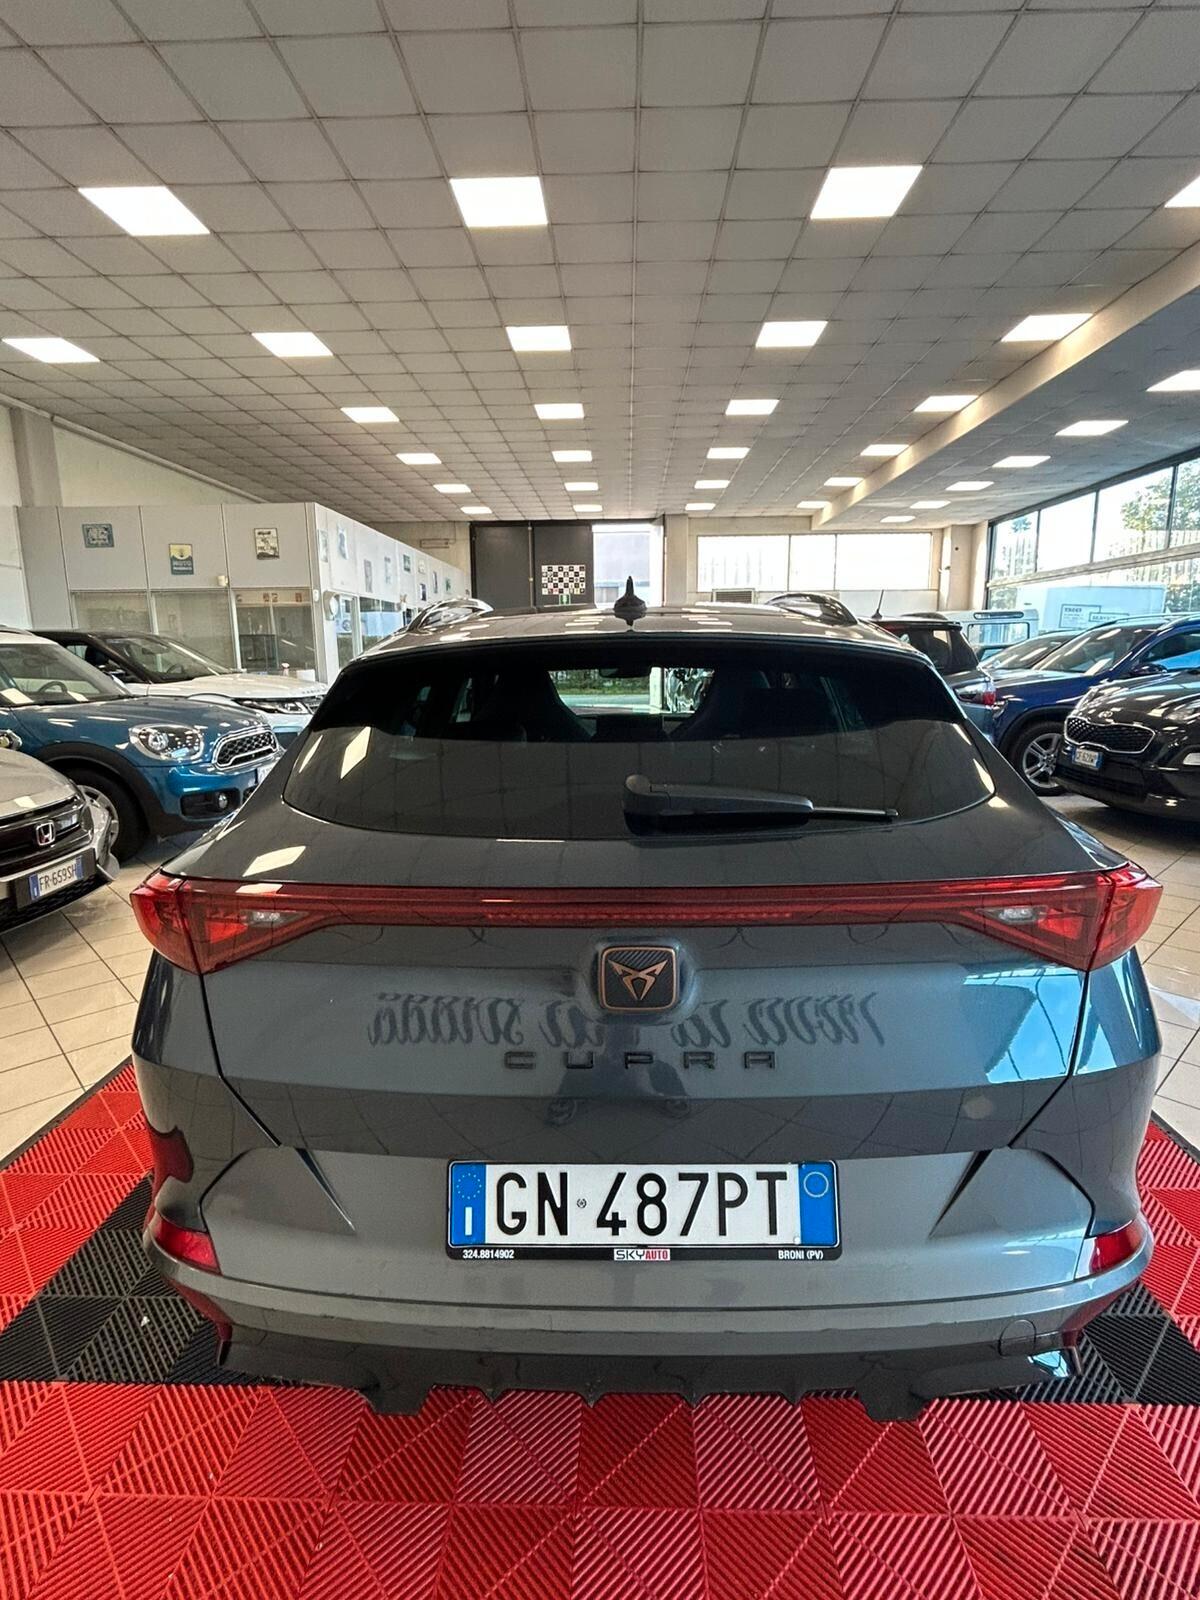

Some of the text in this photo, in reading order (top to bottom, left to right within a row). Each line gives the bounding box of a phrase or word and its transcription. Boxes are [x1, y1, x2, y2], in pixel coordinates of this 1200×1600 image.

[504, 1050, 776, 1070] CUPRA
[495, 1171, 570, 1237] GN
[596, 1171, 788, 1237] 487PT
[462, 1249, 515, 1260] 324.8814902
[778, 1249, 824, 1261] BRONI (PV)
